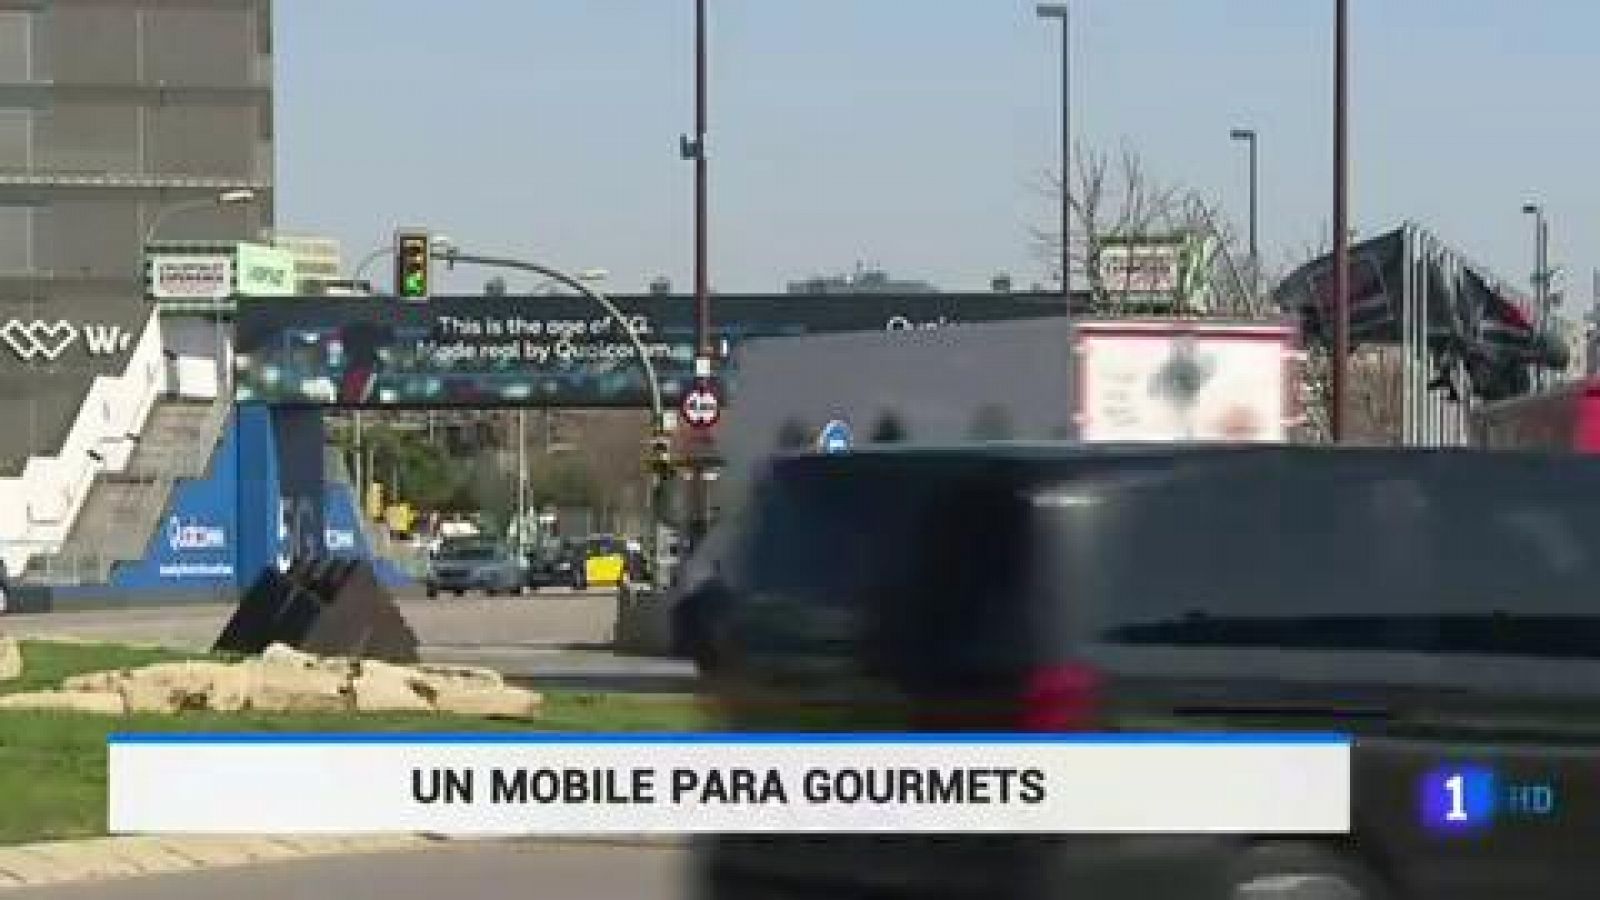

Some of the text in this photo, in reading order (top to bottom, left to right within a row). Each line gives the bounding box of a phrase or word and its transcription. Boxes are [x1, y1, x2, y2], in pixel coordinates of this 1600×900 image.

[437, 316, 481, 335] This
[486, 316, 503, 335] is
[506, 316, 543, 335] the
[523, 340, 550, 364] by
